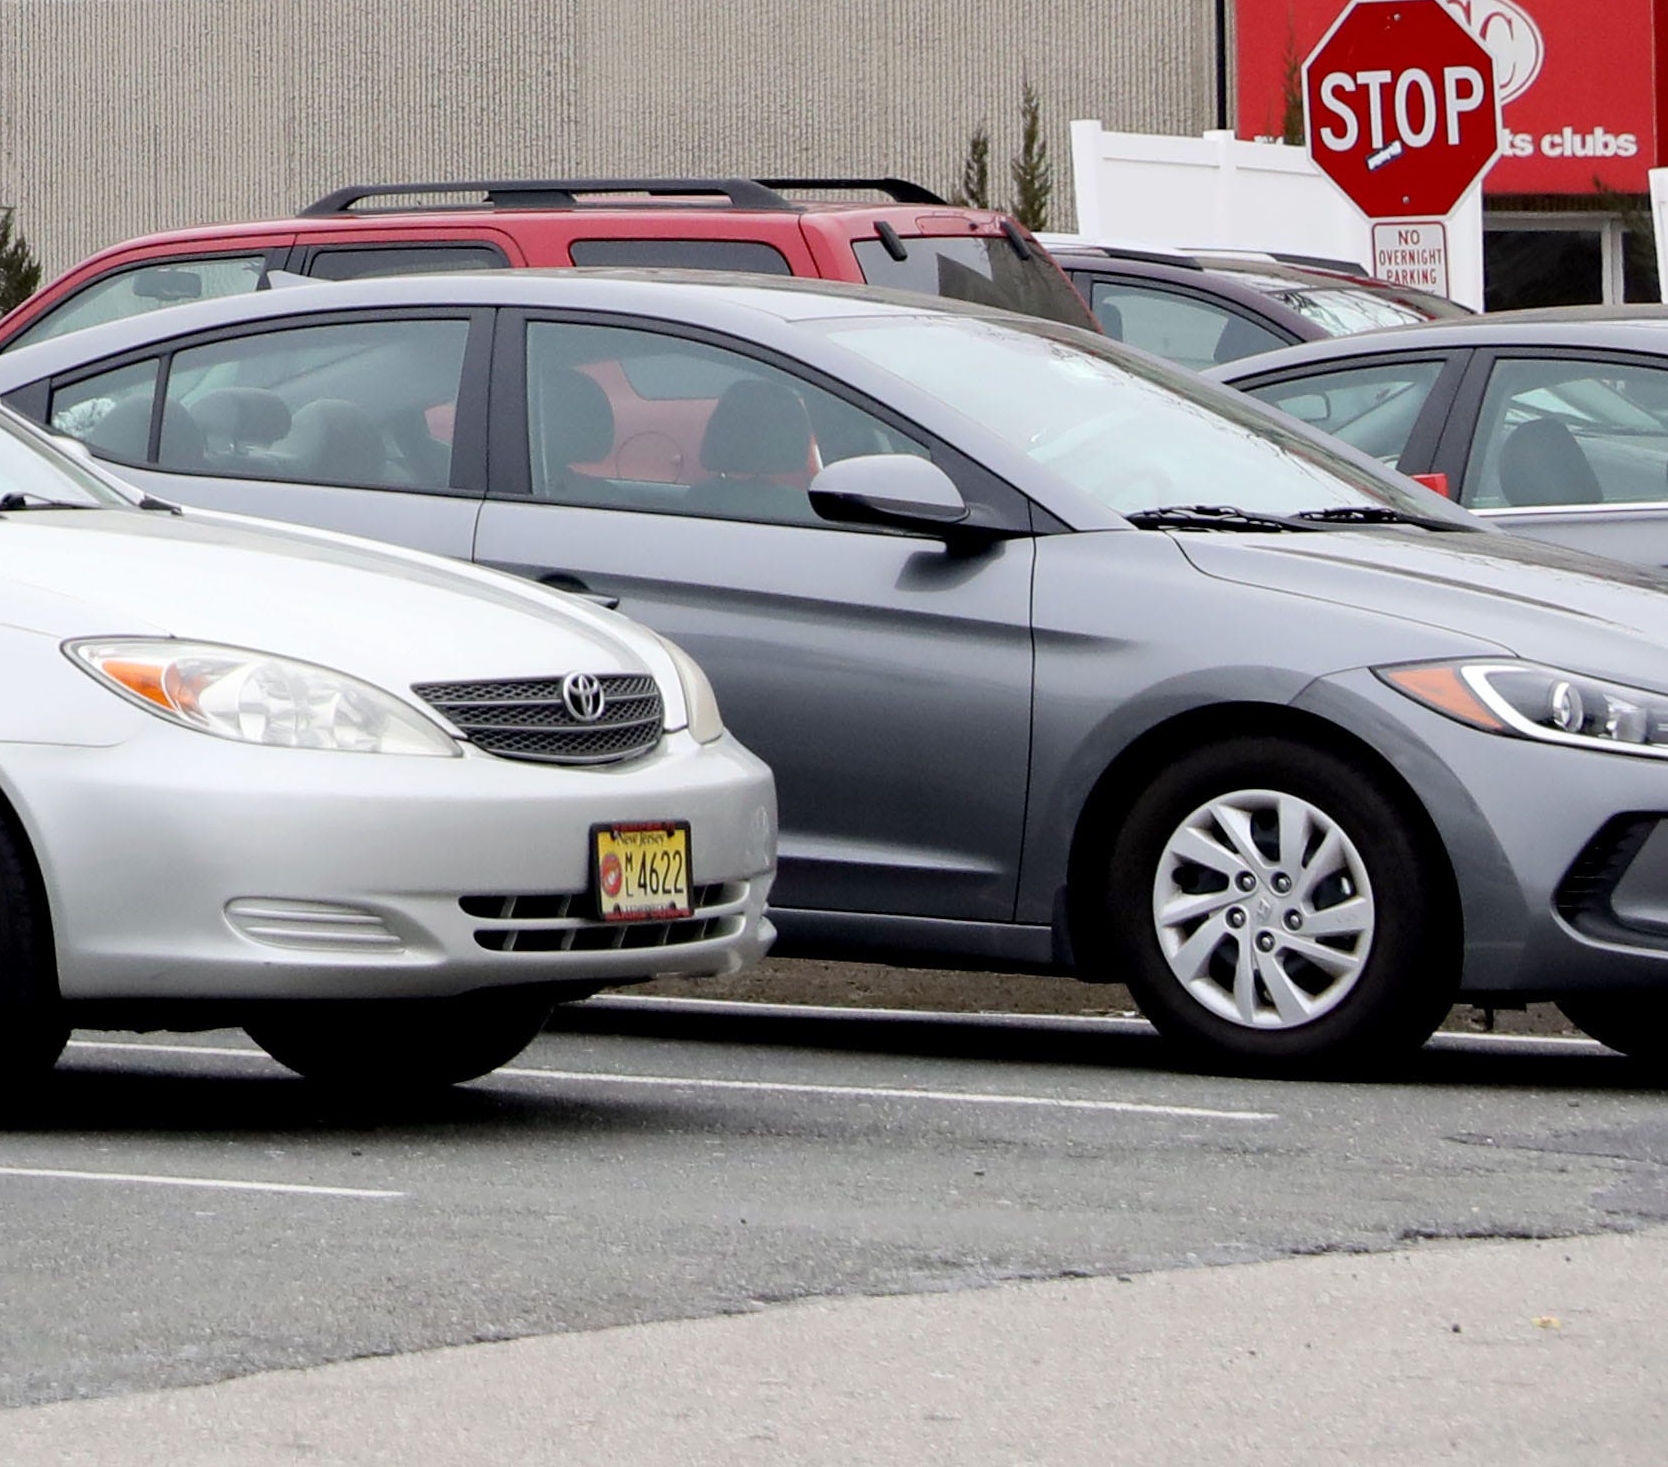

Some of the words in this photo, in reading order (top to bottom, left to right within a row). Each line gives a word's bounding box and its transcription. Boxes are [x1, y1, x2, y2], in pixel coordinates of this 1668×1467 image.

[1319, 65, 1485, 152] STOP
[1540, 126, 1638, 157] clubs
[1398, 229, 1420, 246] NO
[1378, 248, 1443, 266] OVERNIGHT
[1386, 267, 1437, 285] PARKING
